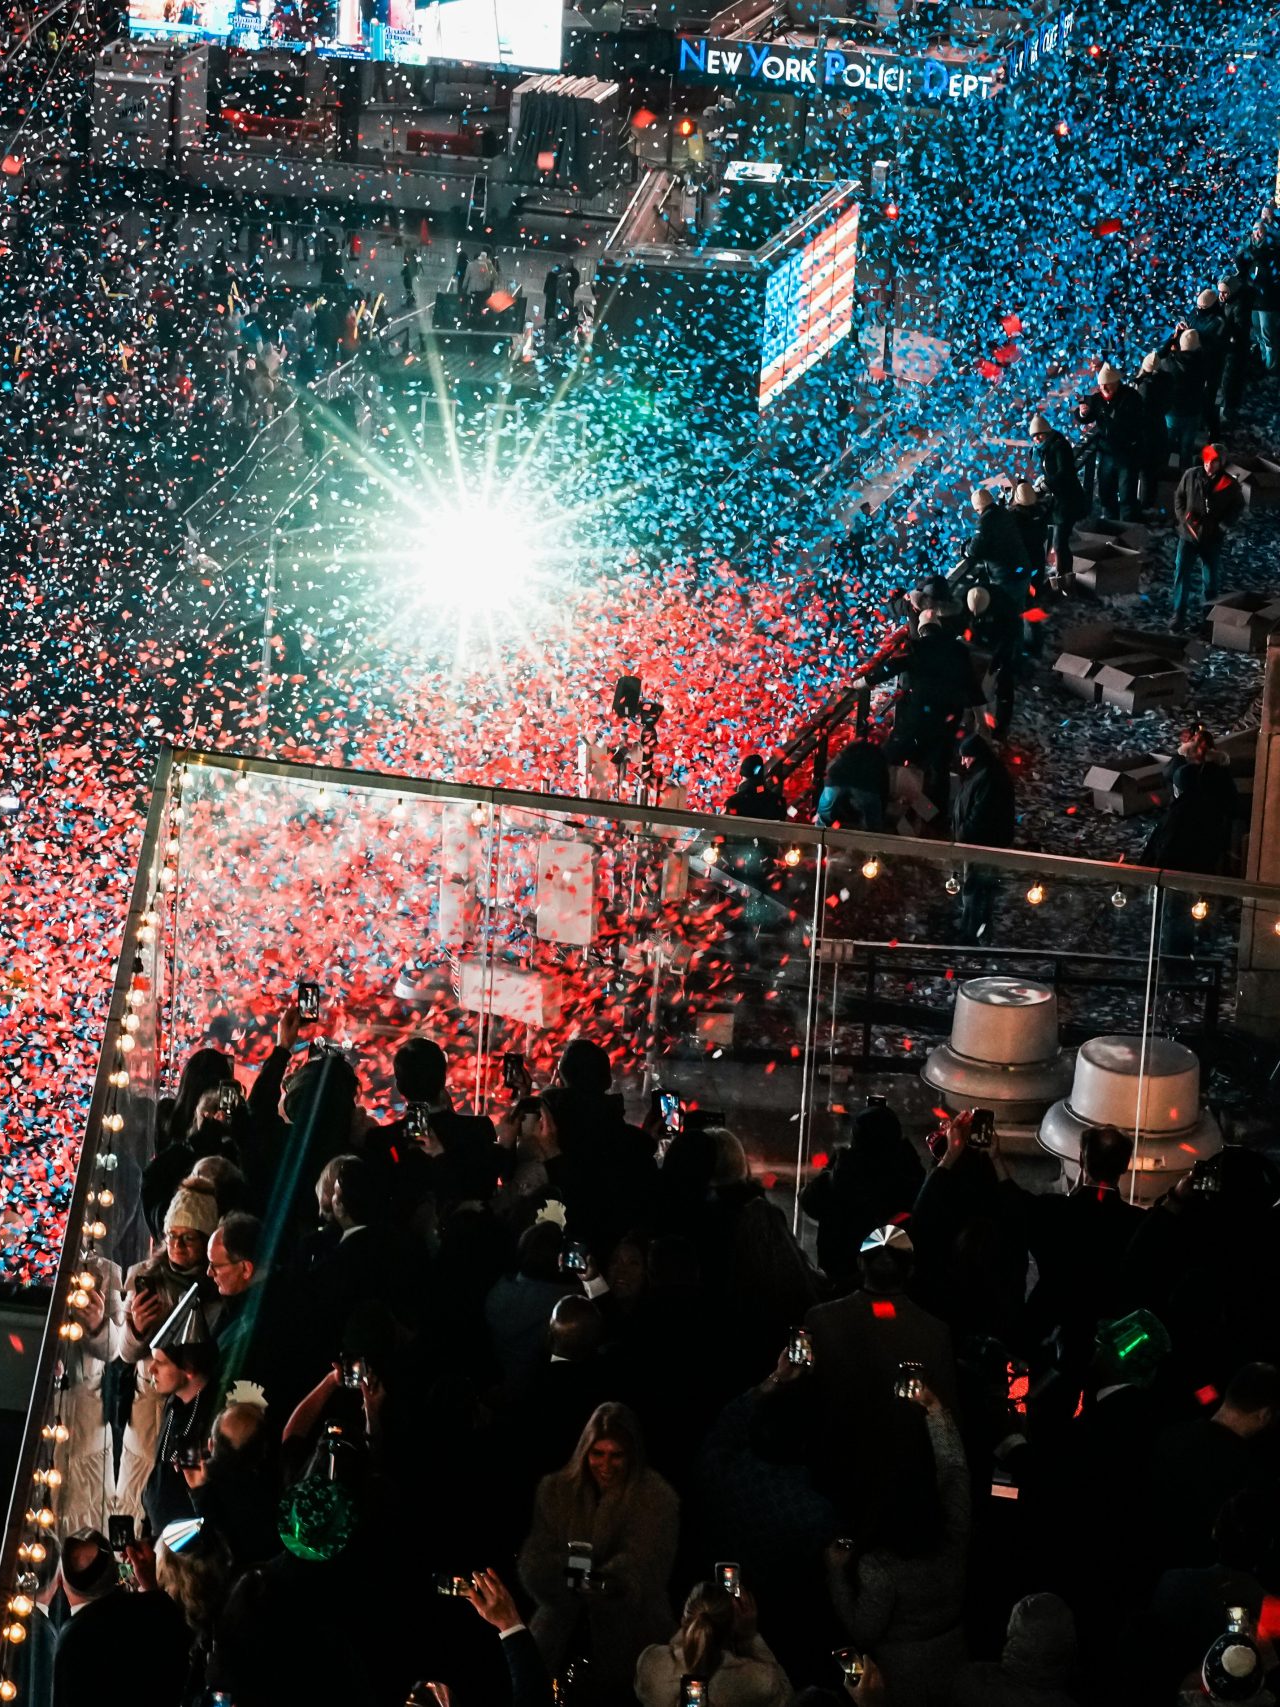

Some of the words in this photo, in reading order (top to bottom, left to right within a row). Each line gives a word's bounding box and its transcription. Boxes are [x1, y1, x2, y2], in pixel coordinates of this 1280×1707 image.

[679, 38, 742, 75] NEW
[746, 45, 816, 84] YORK
[923, 60, 993, 99] DEPT
